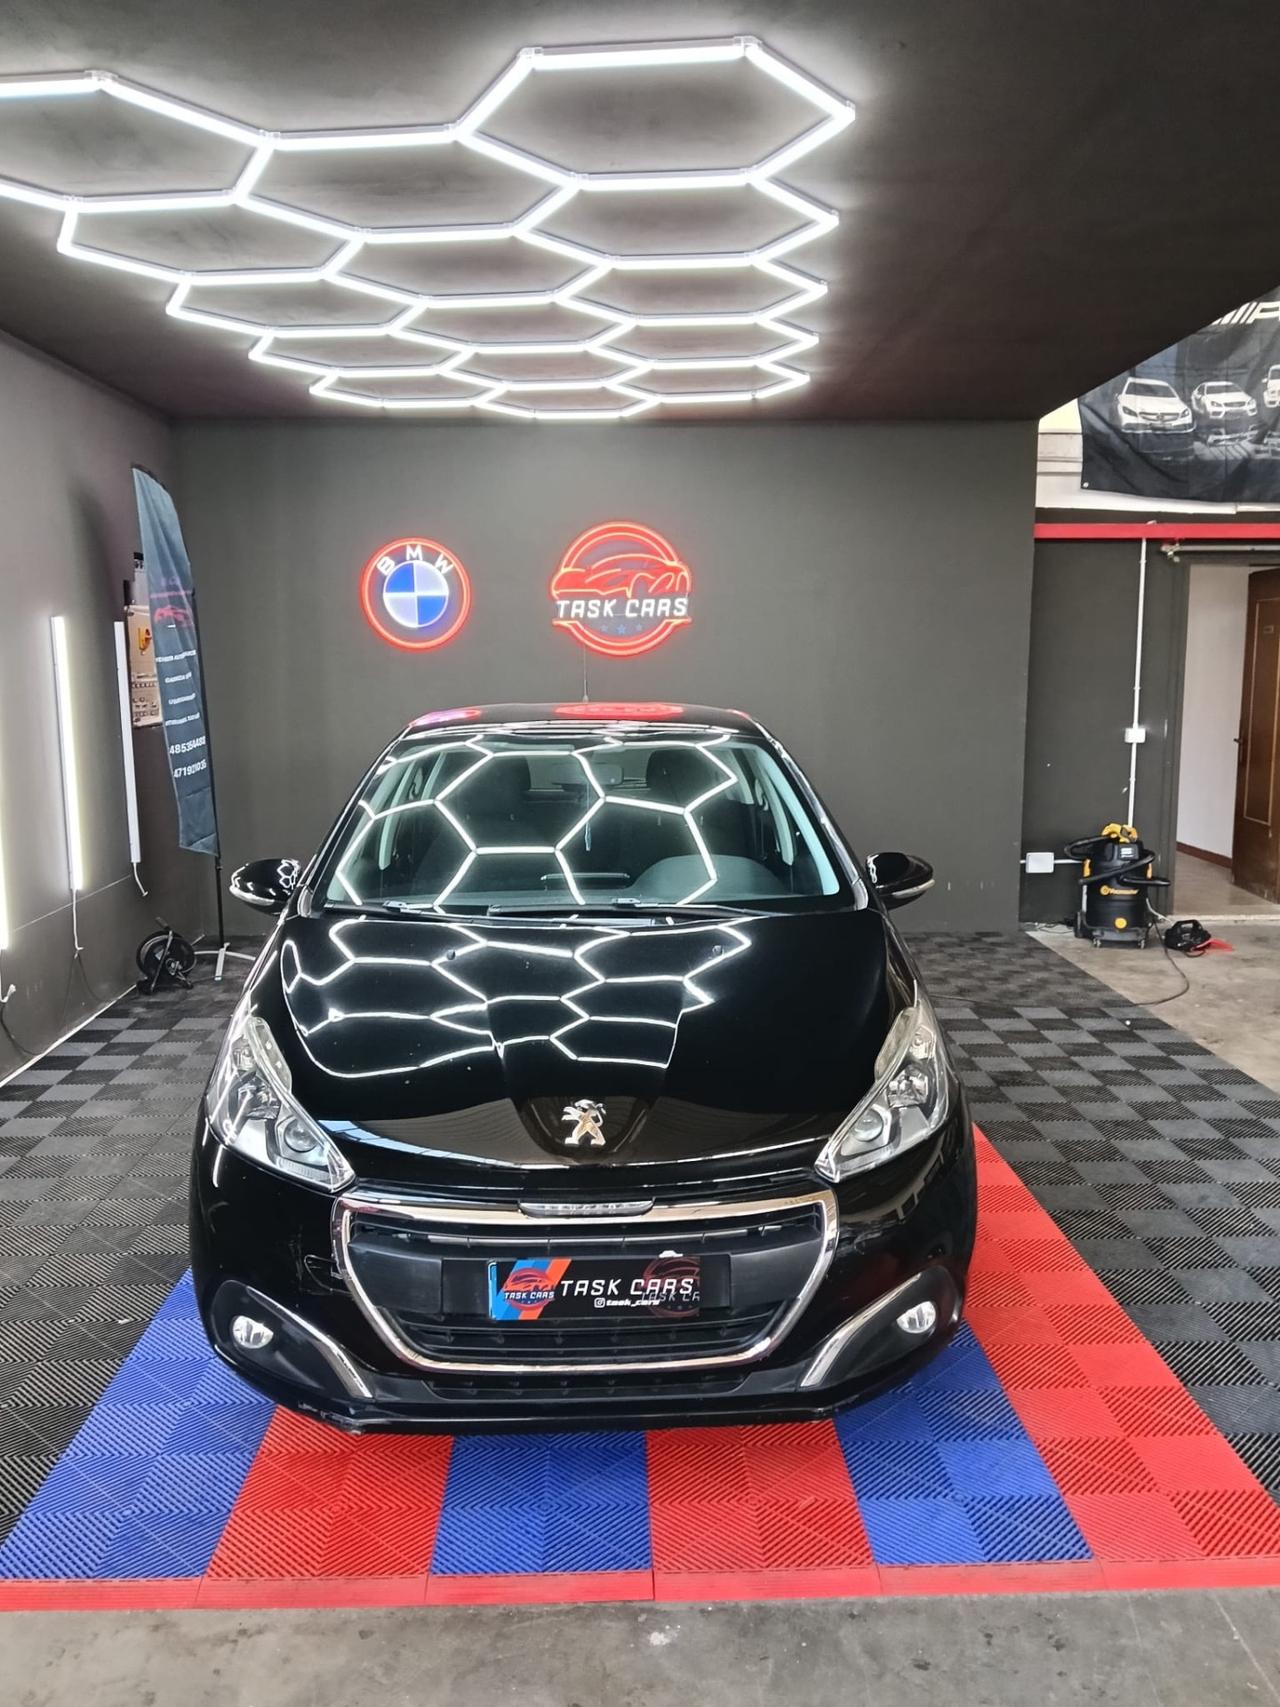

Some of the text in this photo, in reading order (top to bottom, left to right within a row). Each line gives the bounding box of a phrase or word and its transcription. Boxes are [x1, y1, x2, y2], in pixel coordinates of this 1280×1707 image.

[376, 543, 454, 576] BMW
[556, 597, 688, 618] TASK CARS
[504, 1291, 556, 1300] TASK CARS
[561, 1278, 694, 1297] TASK CARS
